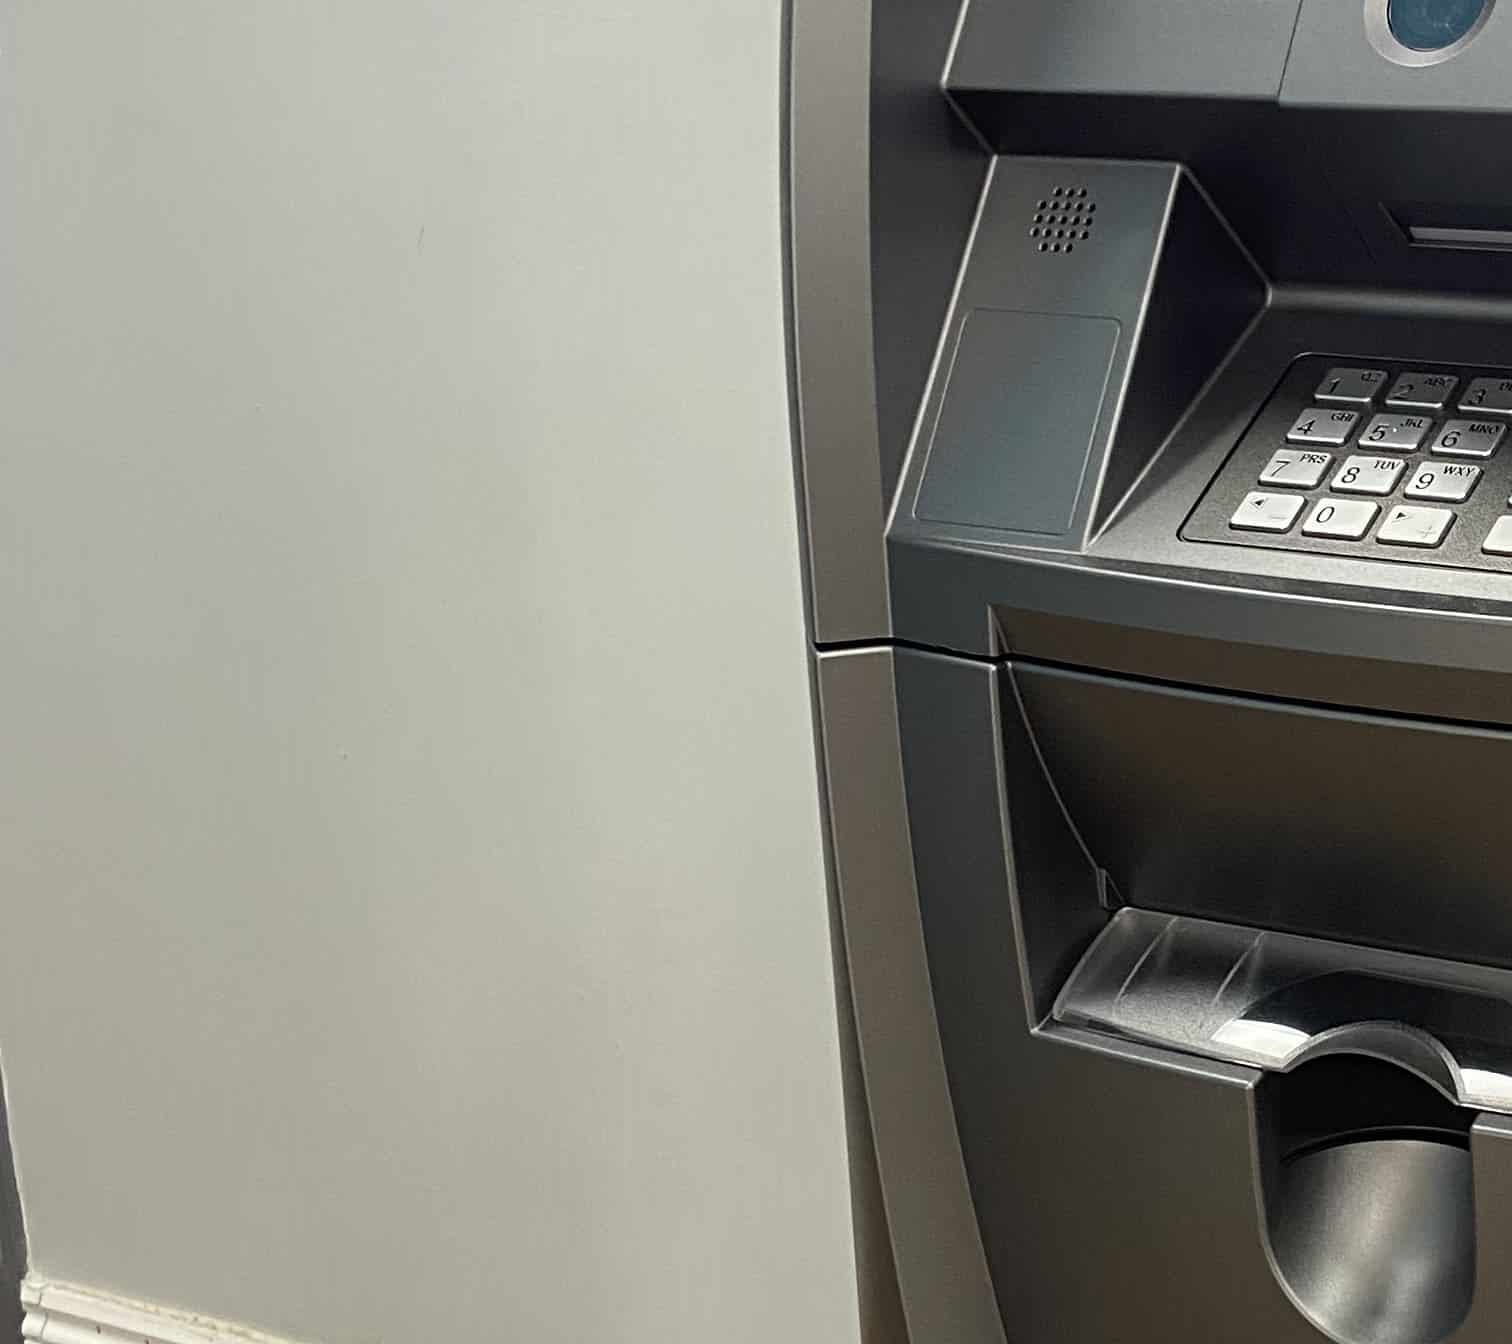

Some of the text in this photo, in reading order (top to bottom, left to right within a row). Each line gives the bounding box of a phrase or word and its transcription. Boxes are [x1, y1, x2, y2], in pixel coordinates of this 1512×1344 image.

[1328, 376, 1342, 394] 1
[1392, 383, 1414, 400] 2
[1467, 388, 1487, 405] 3
[1297, 419, 1316, 435] 4
[1369, 424, 1388, 441] 5
[1441, 430, 1461, 448] 6
[1271, 453, 1327, 477] 7 PRS
[1341, 459, 1400, 484] 8 TUV
[1415, 465, 1476, 490] 9 WXY
[1316, 506, 1335, 524] 0
